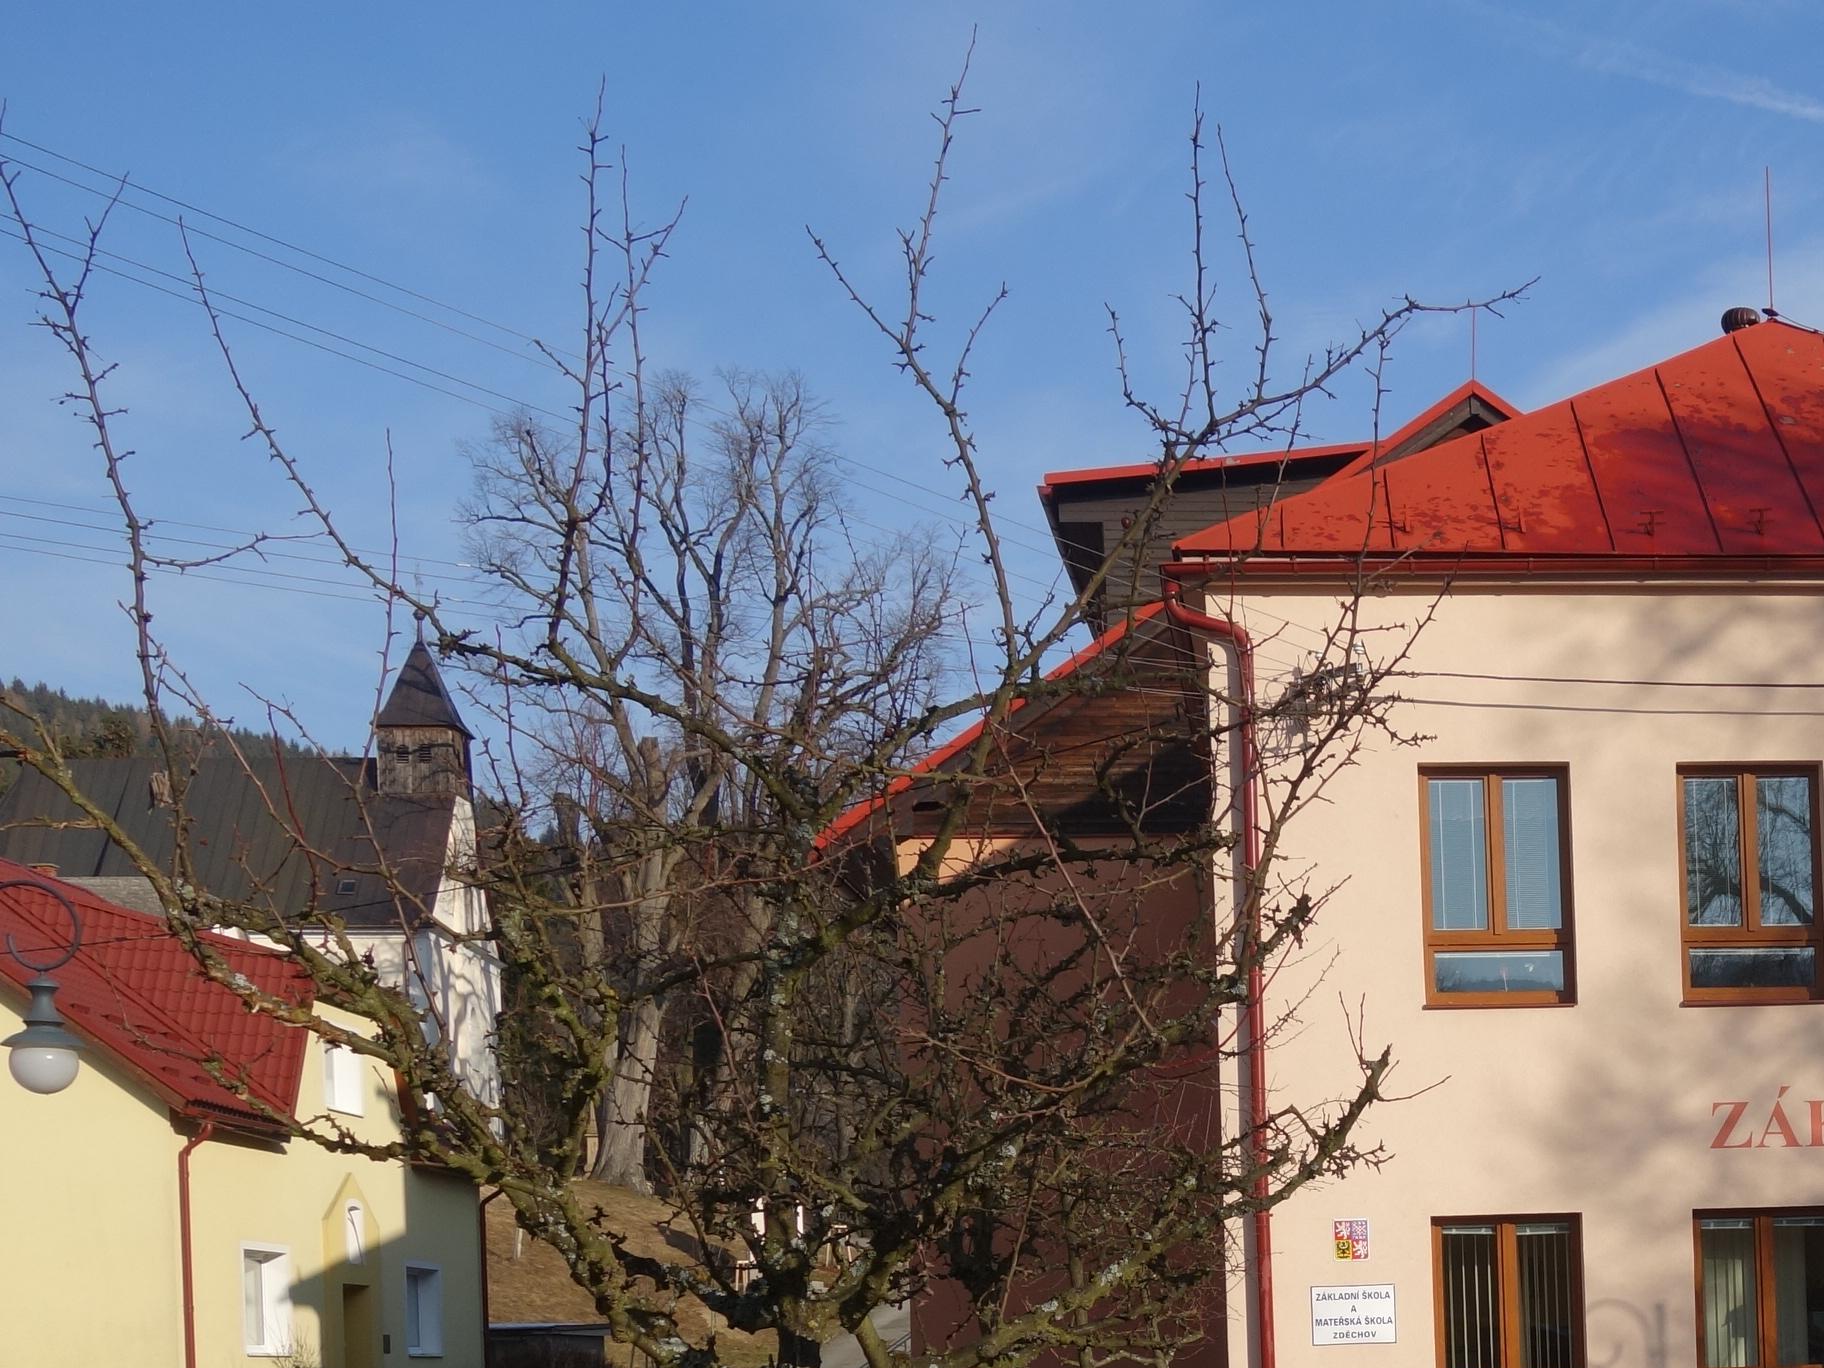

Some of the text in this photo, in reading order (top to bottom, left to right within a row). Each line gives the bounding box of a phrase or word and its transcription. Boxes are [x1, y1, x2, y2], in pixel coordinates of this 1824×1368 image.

[1316, 1290, 1391, 1301] ZÁKLADNÍ ŠKOLA
[1350, 1305, 1357, 1313] A
[1315, 1315, 1393, 1327] MATEŘSKÁ ŠKOLA
